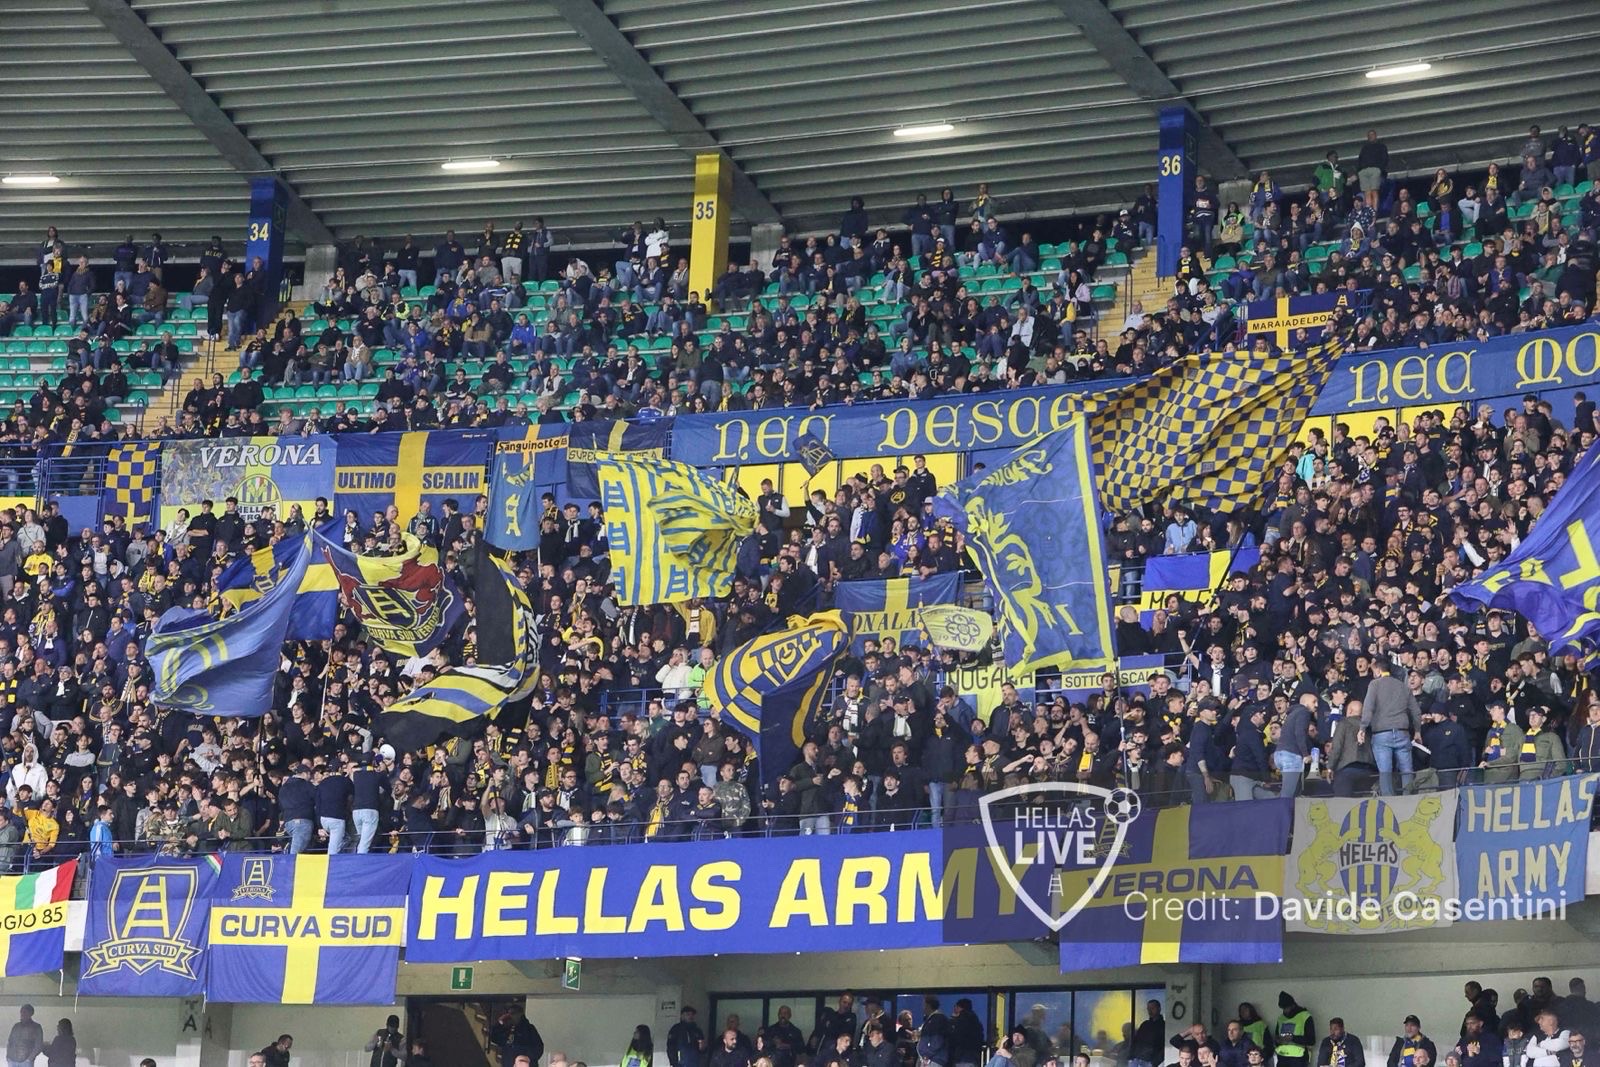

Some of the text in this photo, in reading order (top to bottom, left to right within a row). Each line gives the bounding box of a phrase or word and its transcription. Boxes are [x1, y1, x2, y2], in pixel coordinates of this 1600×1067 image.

[1161, 154, 1181, 177] 36
[695, 200, 714, 220] 35
[249, 222, 269, 241] 34
[201, 443, 322, 468] VERONA
[338, 472, 479, 488] ULTIMO SCALIN
[1467, 773, 1599, 833] HELLAS
[1339, 841, 1398, 867] HELLAS
[1088, 864, 1260, 899] VERONA
[1477, 840, 1572, 900] ARMY
[417, 842, 1046, 940] HELLAS ARMY
[0, 906, 63, 930] GIO 85
[221, 914, 392, 938] CURVA SUD
[108, 943, 178, 957] CURVA SUD
